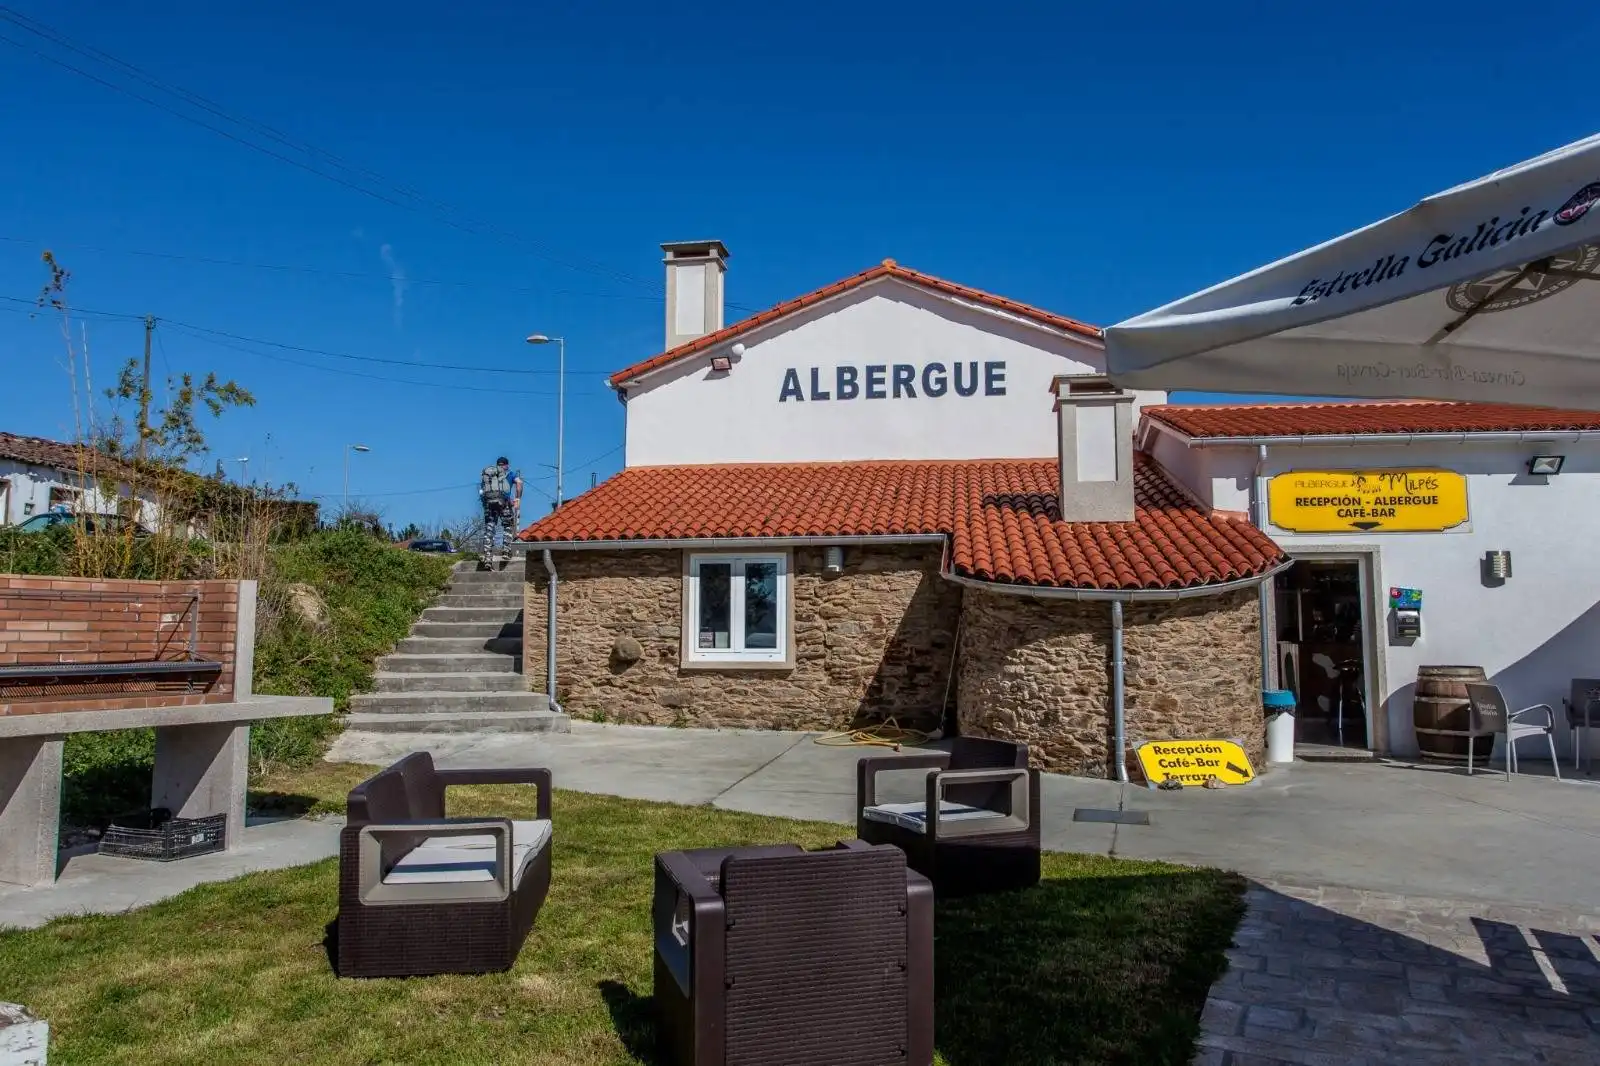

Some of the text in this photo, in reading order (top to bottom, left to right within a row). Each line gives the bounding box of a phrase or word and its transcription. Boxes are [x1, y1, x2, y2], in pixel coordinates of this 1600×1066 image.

[1291, 254, 1410, 305] Estrella
[1417, 206, 1549, 268] Galicia
[779, 361, 1007, 402] ALBERGUE
[1295, 494, 1362, 507] RECEPCIÓN
[1374, 496, 1439, 506] ALBERGUE
[1337, 506, 1396, 518] CAFÉ-BAR
[1152, 744, 1223, 756] Recepción
[1158, 757, 1220, 768] Café-Bar
